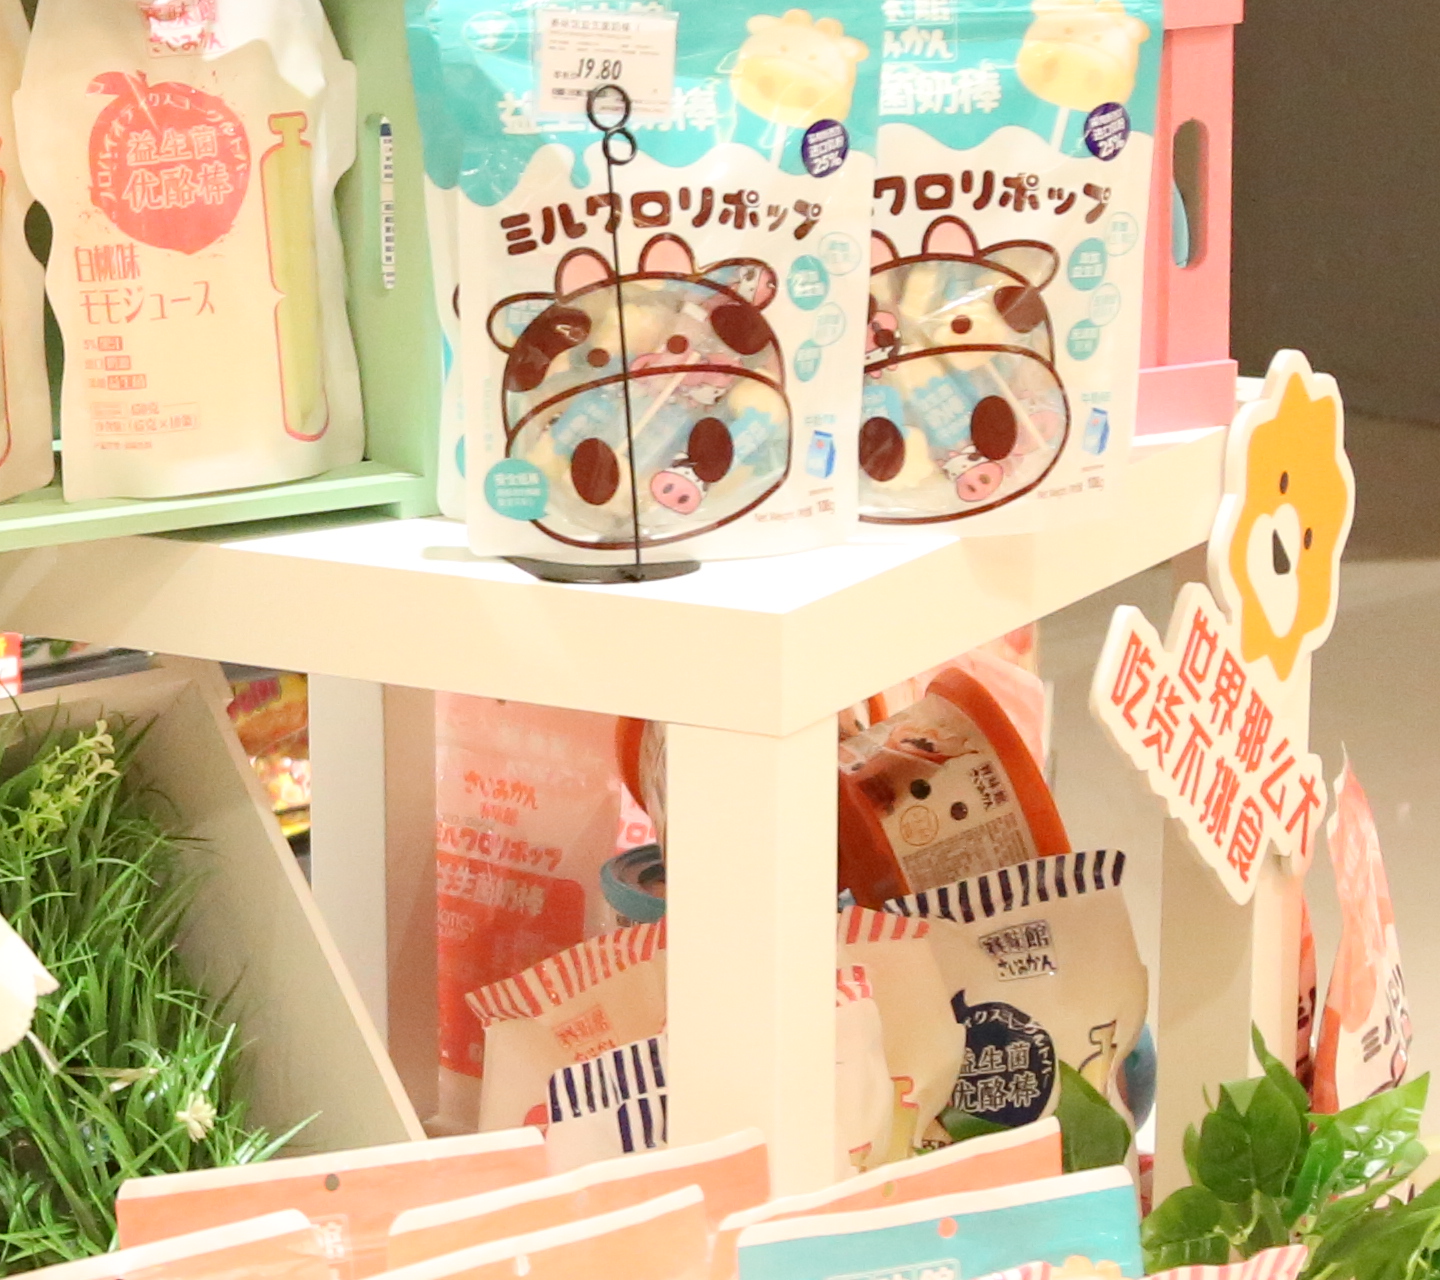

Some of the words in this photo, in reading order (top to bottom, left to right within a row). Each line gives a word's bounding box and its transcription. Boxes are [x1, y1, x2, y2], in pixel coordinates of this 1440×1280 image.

[575, 56, 623, 81] 19.80
[125, 124, 220, 167] 益生菌
[122, 161, 235, 211] 优酪棒
[499, 172, 823, 255] ミルクロリポップ
[75, 242, 141, 283] 白桃味
[79, 280, 216, 325] モモジュース
[1178, 606, 1322, 859] 世界那么大
[1110, 630, 1266, 884] 吃货不挑食
